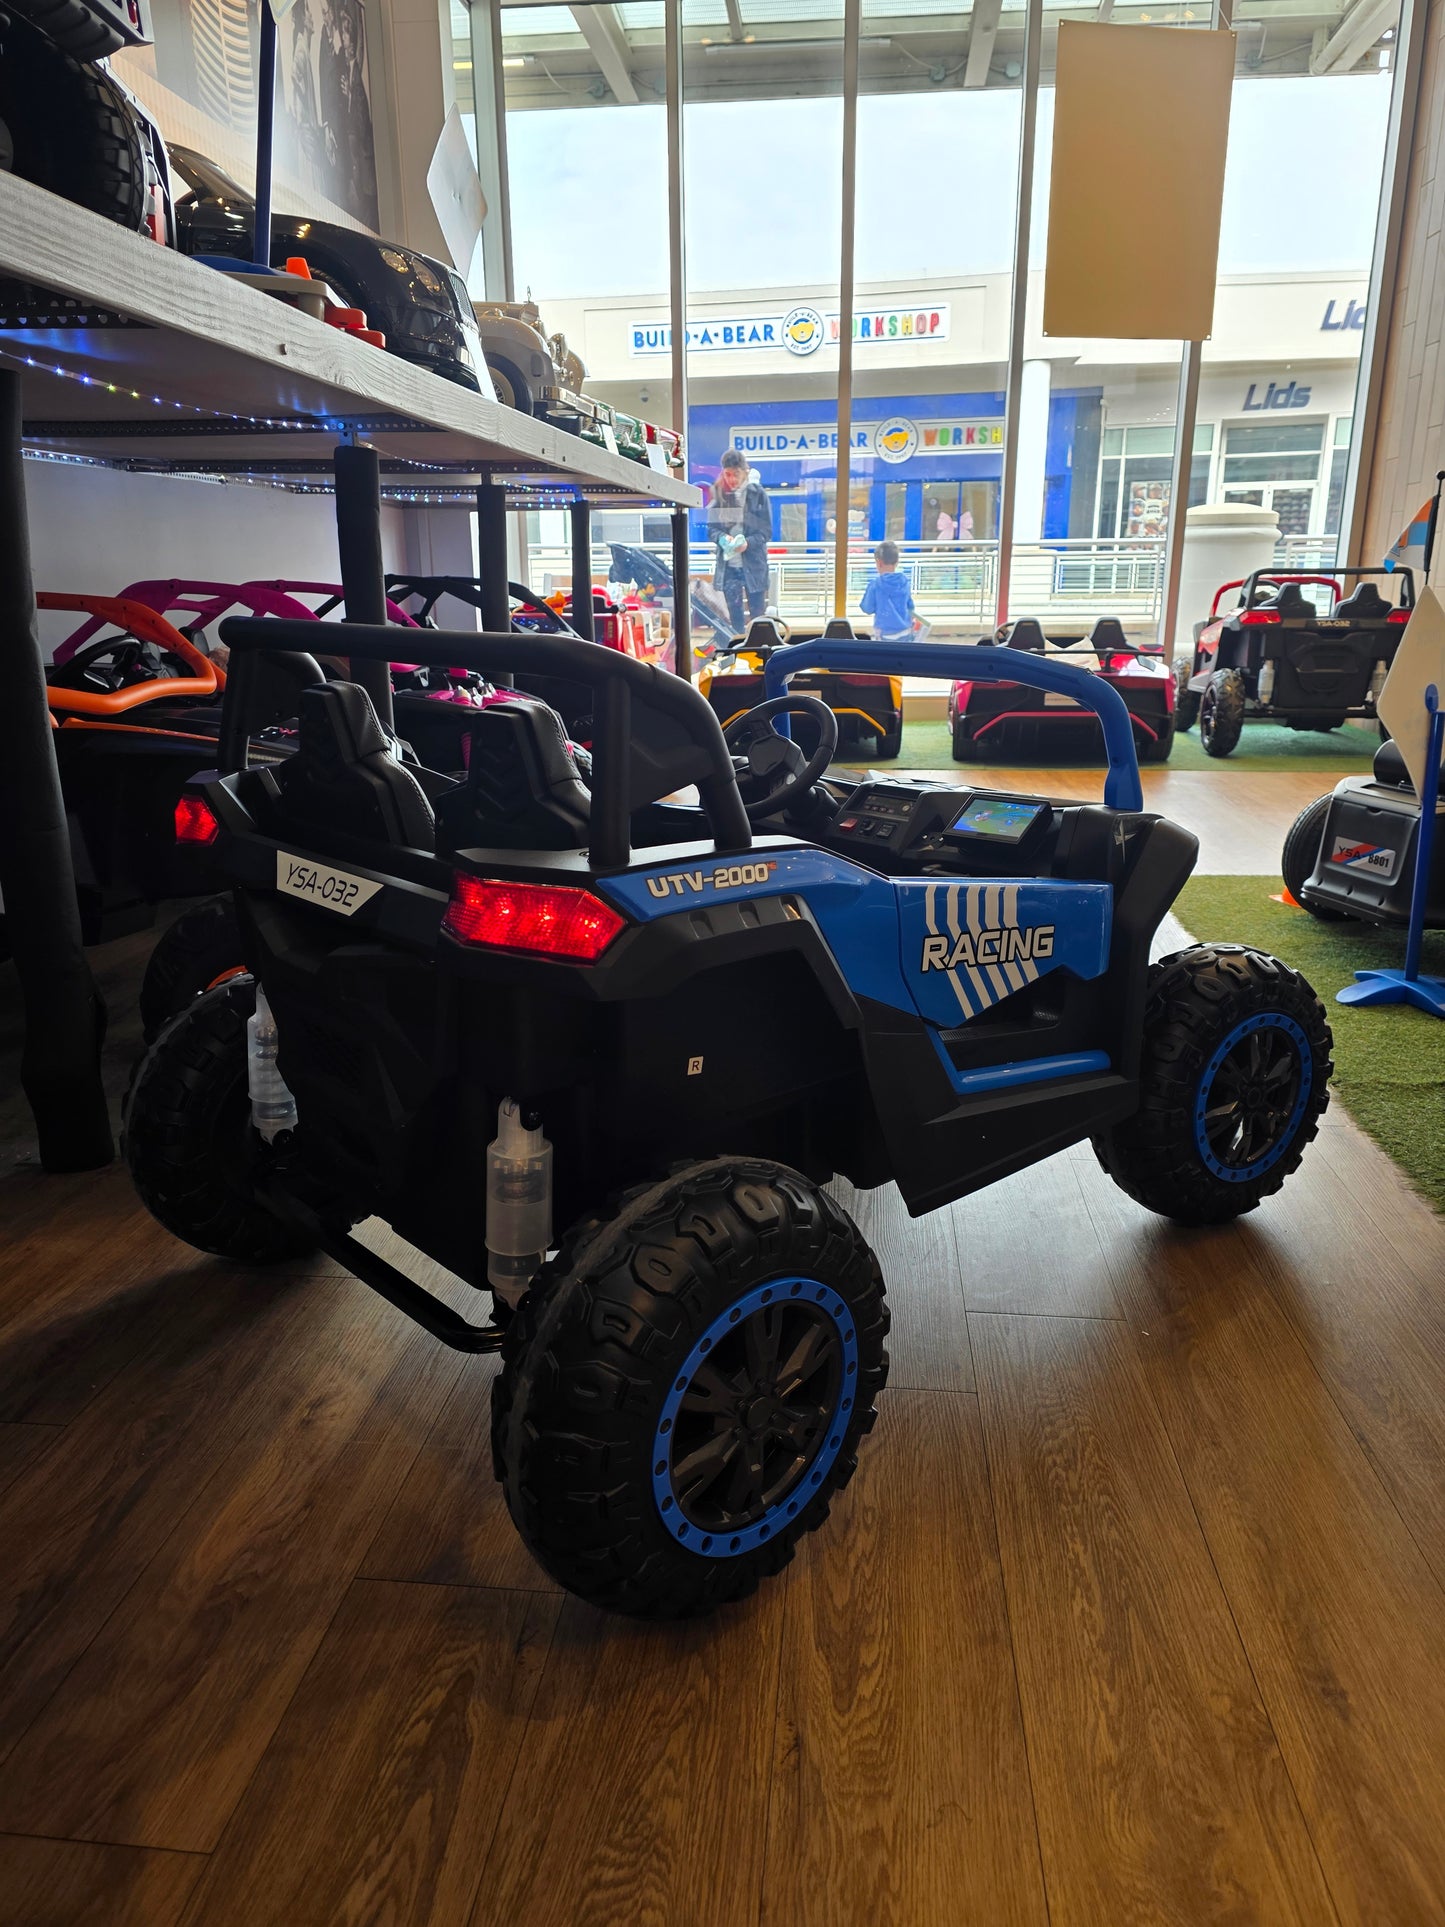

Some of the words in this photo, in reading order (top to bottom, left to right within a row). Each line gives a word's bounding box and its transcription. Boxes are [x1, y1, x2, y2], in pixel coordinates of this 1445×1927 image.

[1242, 381, 1312, 411] Lids
[286, 863, 359, 907] YSA-032
[921, 924, 1055, 972] RACING
[691, 1060, 700, 1072] R
